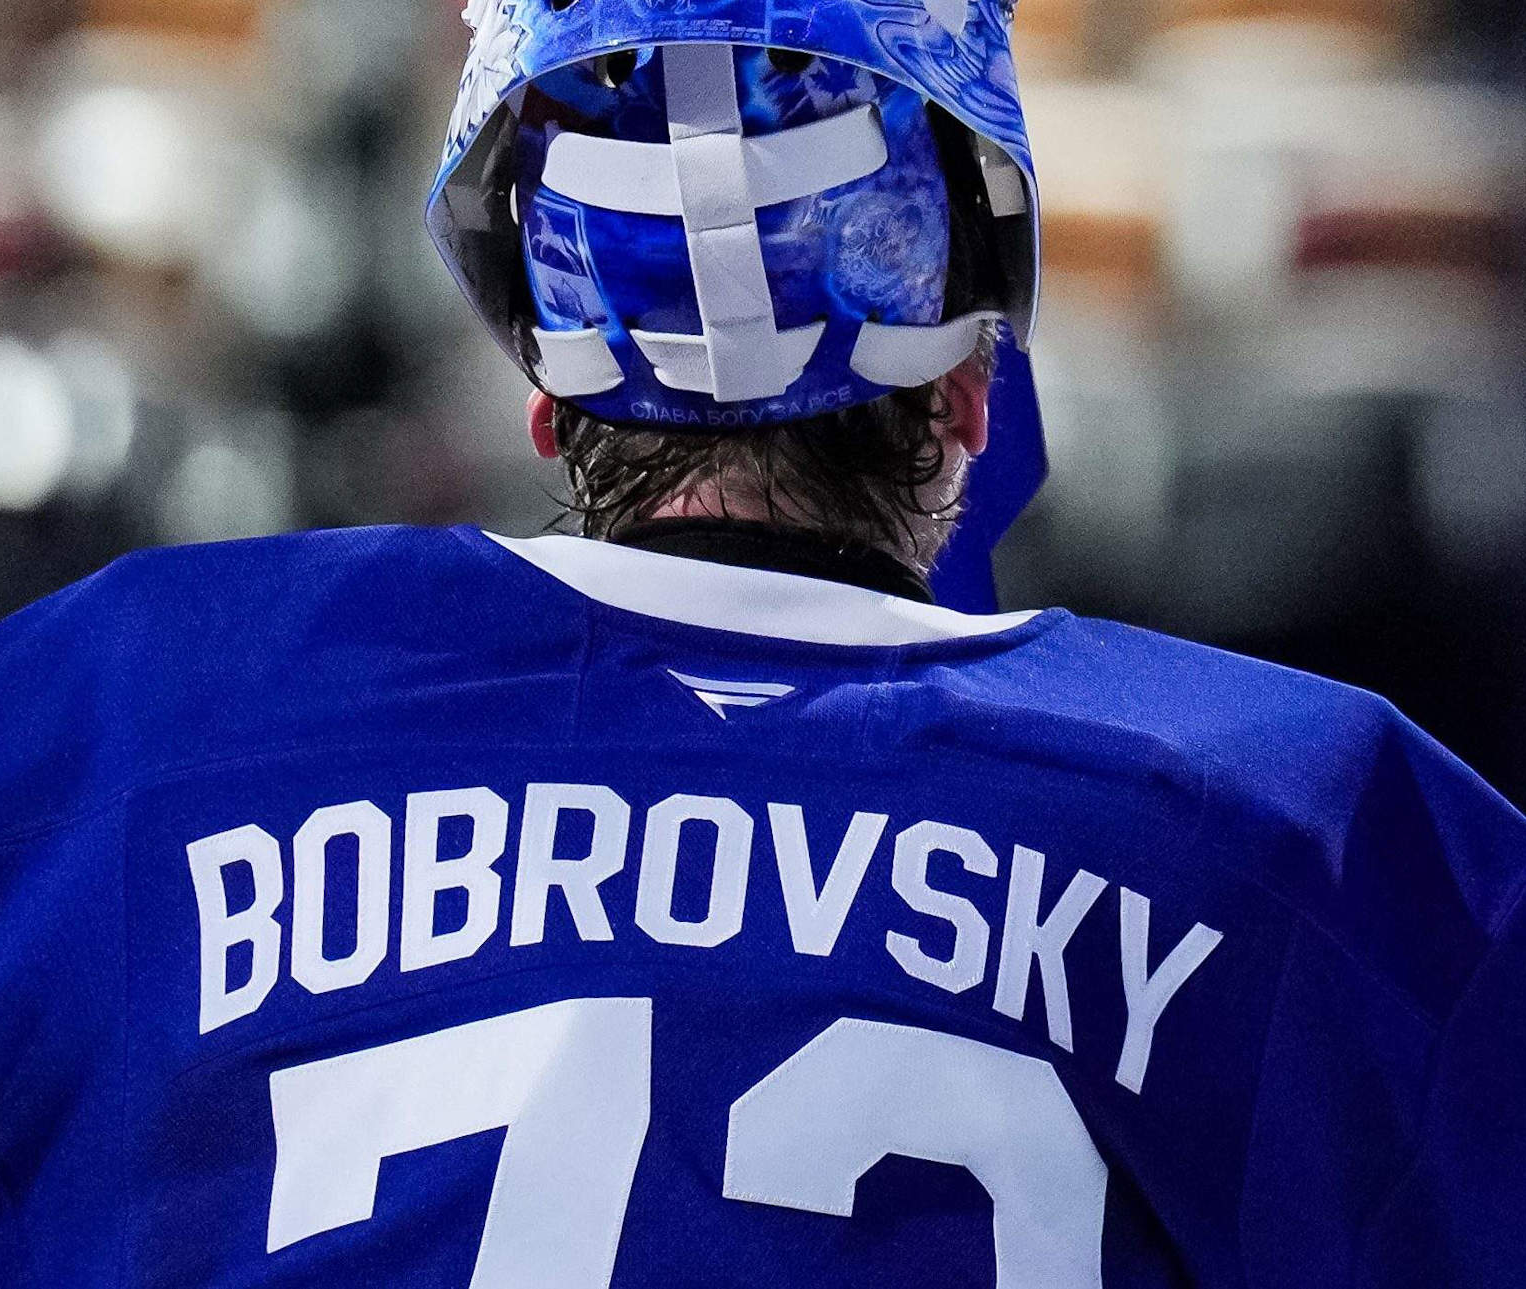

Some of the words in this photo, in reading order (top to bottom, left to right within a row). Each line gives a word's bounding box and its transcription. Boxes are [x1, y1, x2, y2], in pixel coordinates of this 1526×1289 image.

[630, 400, 700, 424] СЛАВА
[706, 409, 765, 426] БОГУ
[186, 783, 1223, 1094] BOBROVSKY
